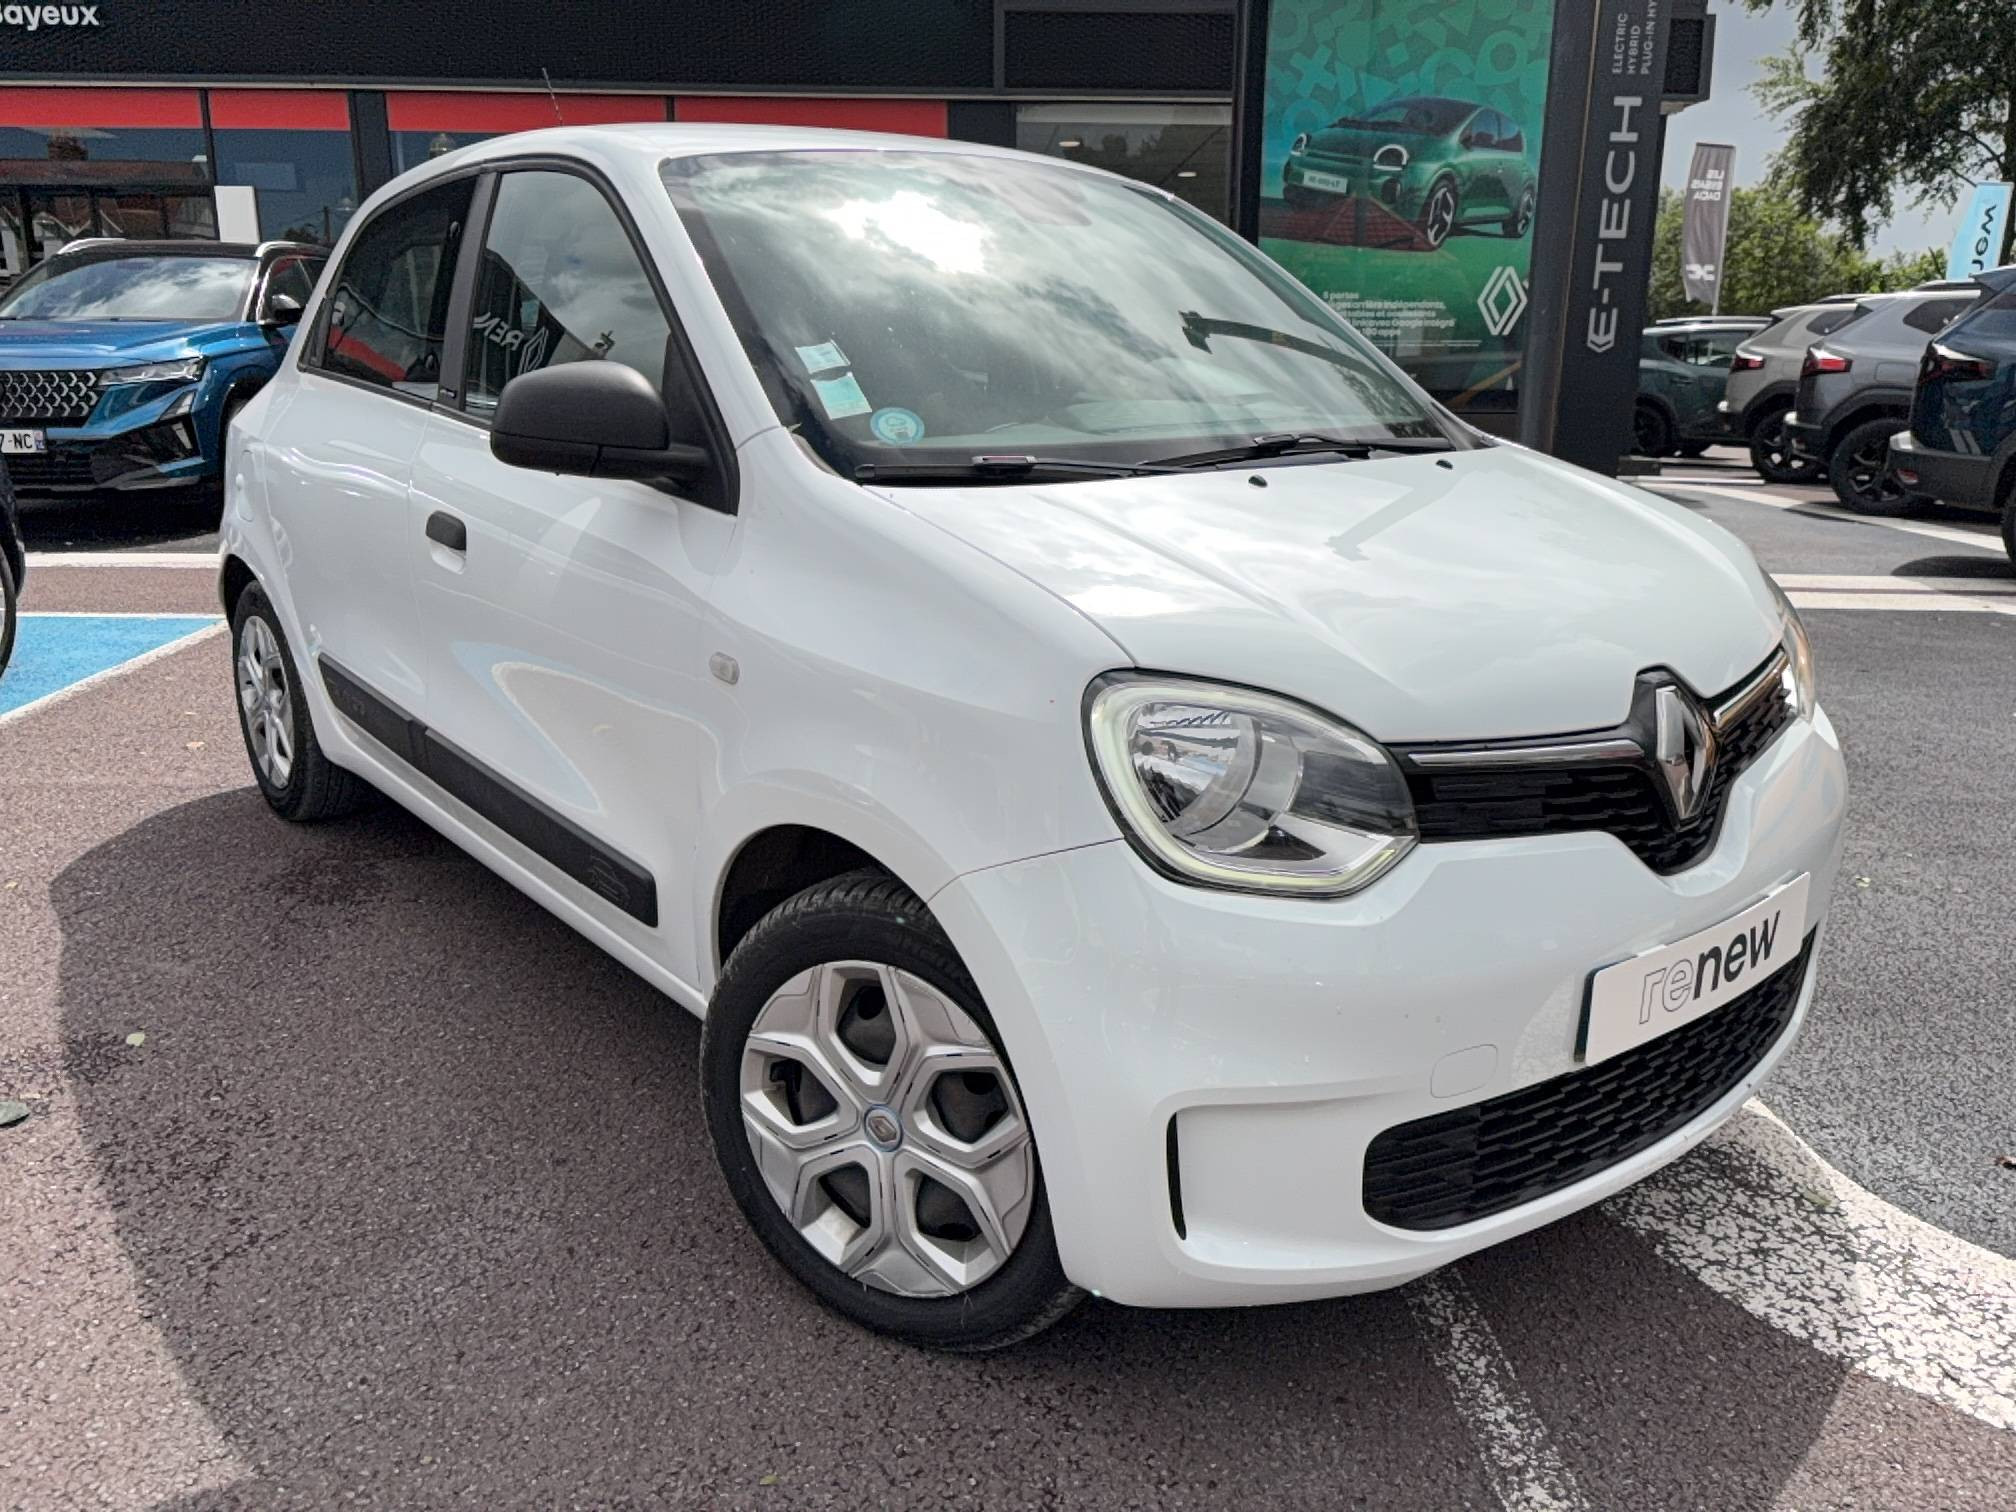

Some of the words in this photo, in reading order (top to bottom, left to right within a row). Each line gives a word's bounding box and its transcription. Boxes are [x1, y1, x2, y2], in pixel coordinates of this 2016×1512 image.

[0, 4, 100, 31] ayeux
[1611, 12, 1628, 74] ELECTRIC
[1627, 25, 1640, 74] HYBRID
[1641, 21, 1656, 75] PLUG-IN
[1587, 96, 1642, 353] E-TECH
[1391, 318, 1423, 329] Google
[1638, 910, 1781, 1025] renew
